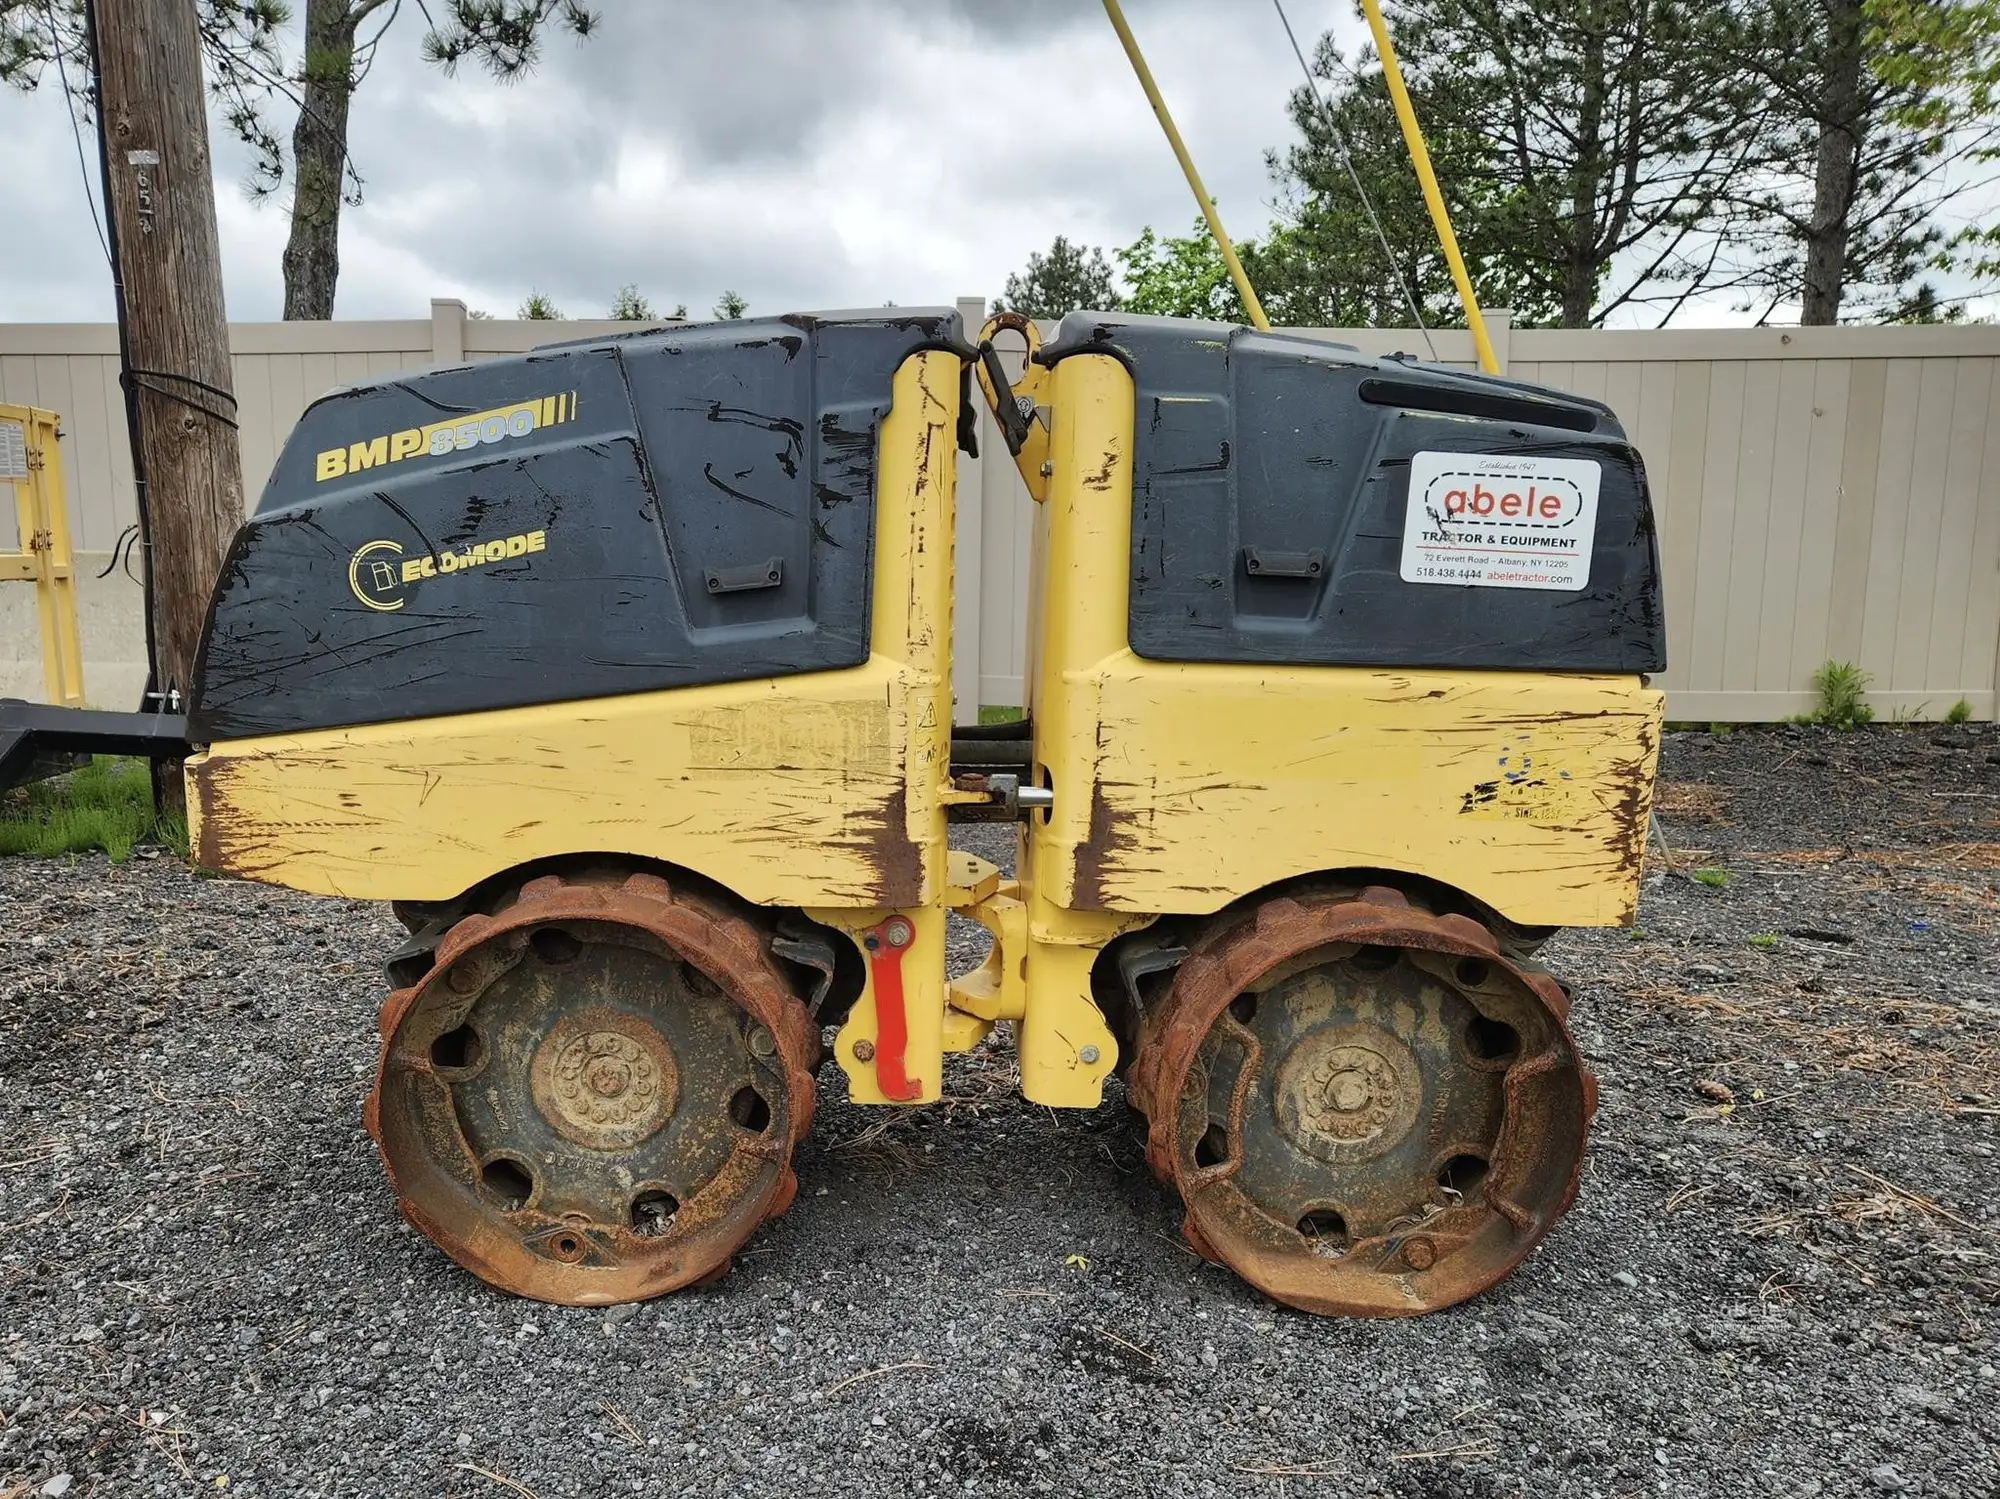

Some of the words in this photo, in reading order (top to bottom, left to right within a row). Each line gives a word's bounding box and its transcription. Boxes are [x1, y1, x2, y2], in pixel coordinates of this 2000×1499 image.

[1444, 484, 1561, 518] abele
[1487, 534, 1496, 544] &
[1501, 535, 1577, 548] EQUIPMENT
[402, 530, 546, 583] ECOMODE
[1423, 553, 1435, 562] 72
[1436, 554, 1465, 564] Everett
[1467, 555, 1489, 564] Road
[1530, 559, 1542, 567] NY
[1545, 559, 1569, 568] 12205
[1416, 567, 1482, 579] 518.438.4444
[1487, 570, 1573, 584] abeletractor.com
